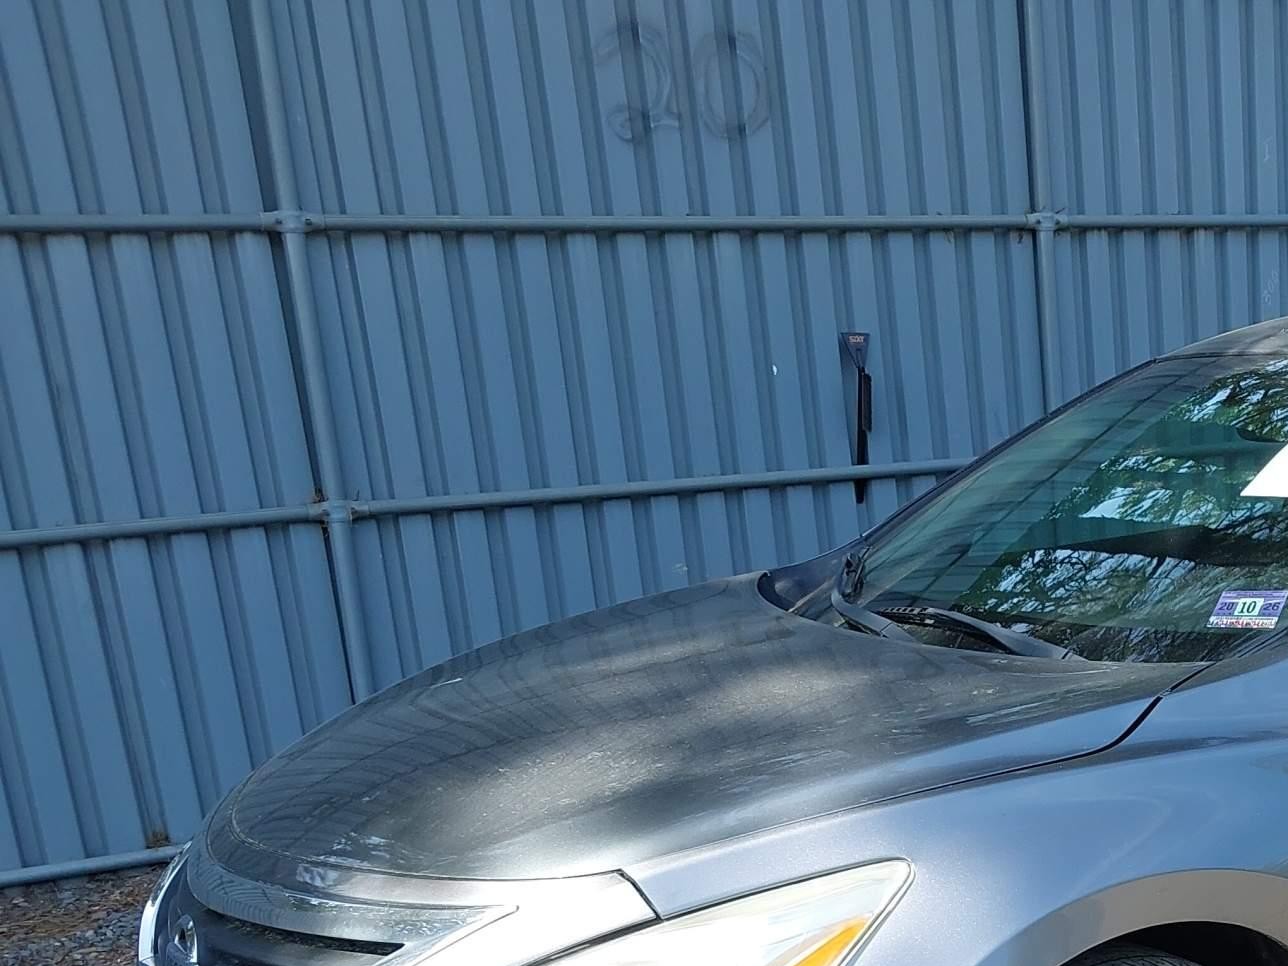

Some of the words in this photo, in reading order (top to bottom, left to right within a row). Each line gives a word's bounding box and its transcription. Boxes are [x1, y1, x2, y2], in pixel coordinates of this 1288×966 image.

[1218, 602, 1235, 611] 20
[1237, 600, 1257, 614] 10
[1262, 602, 1281, 611] 26
